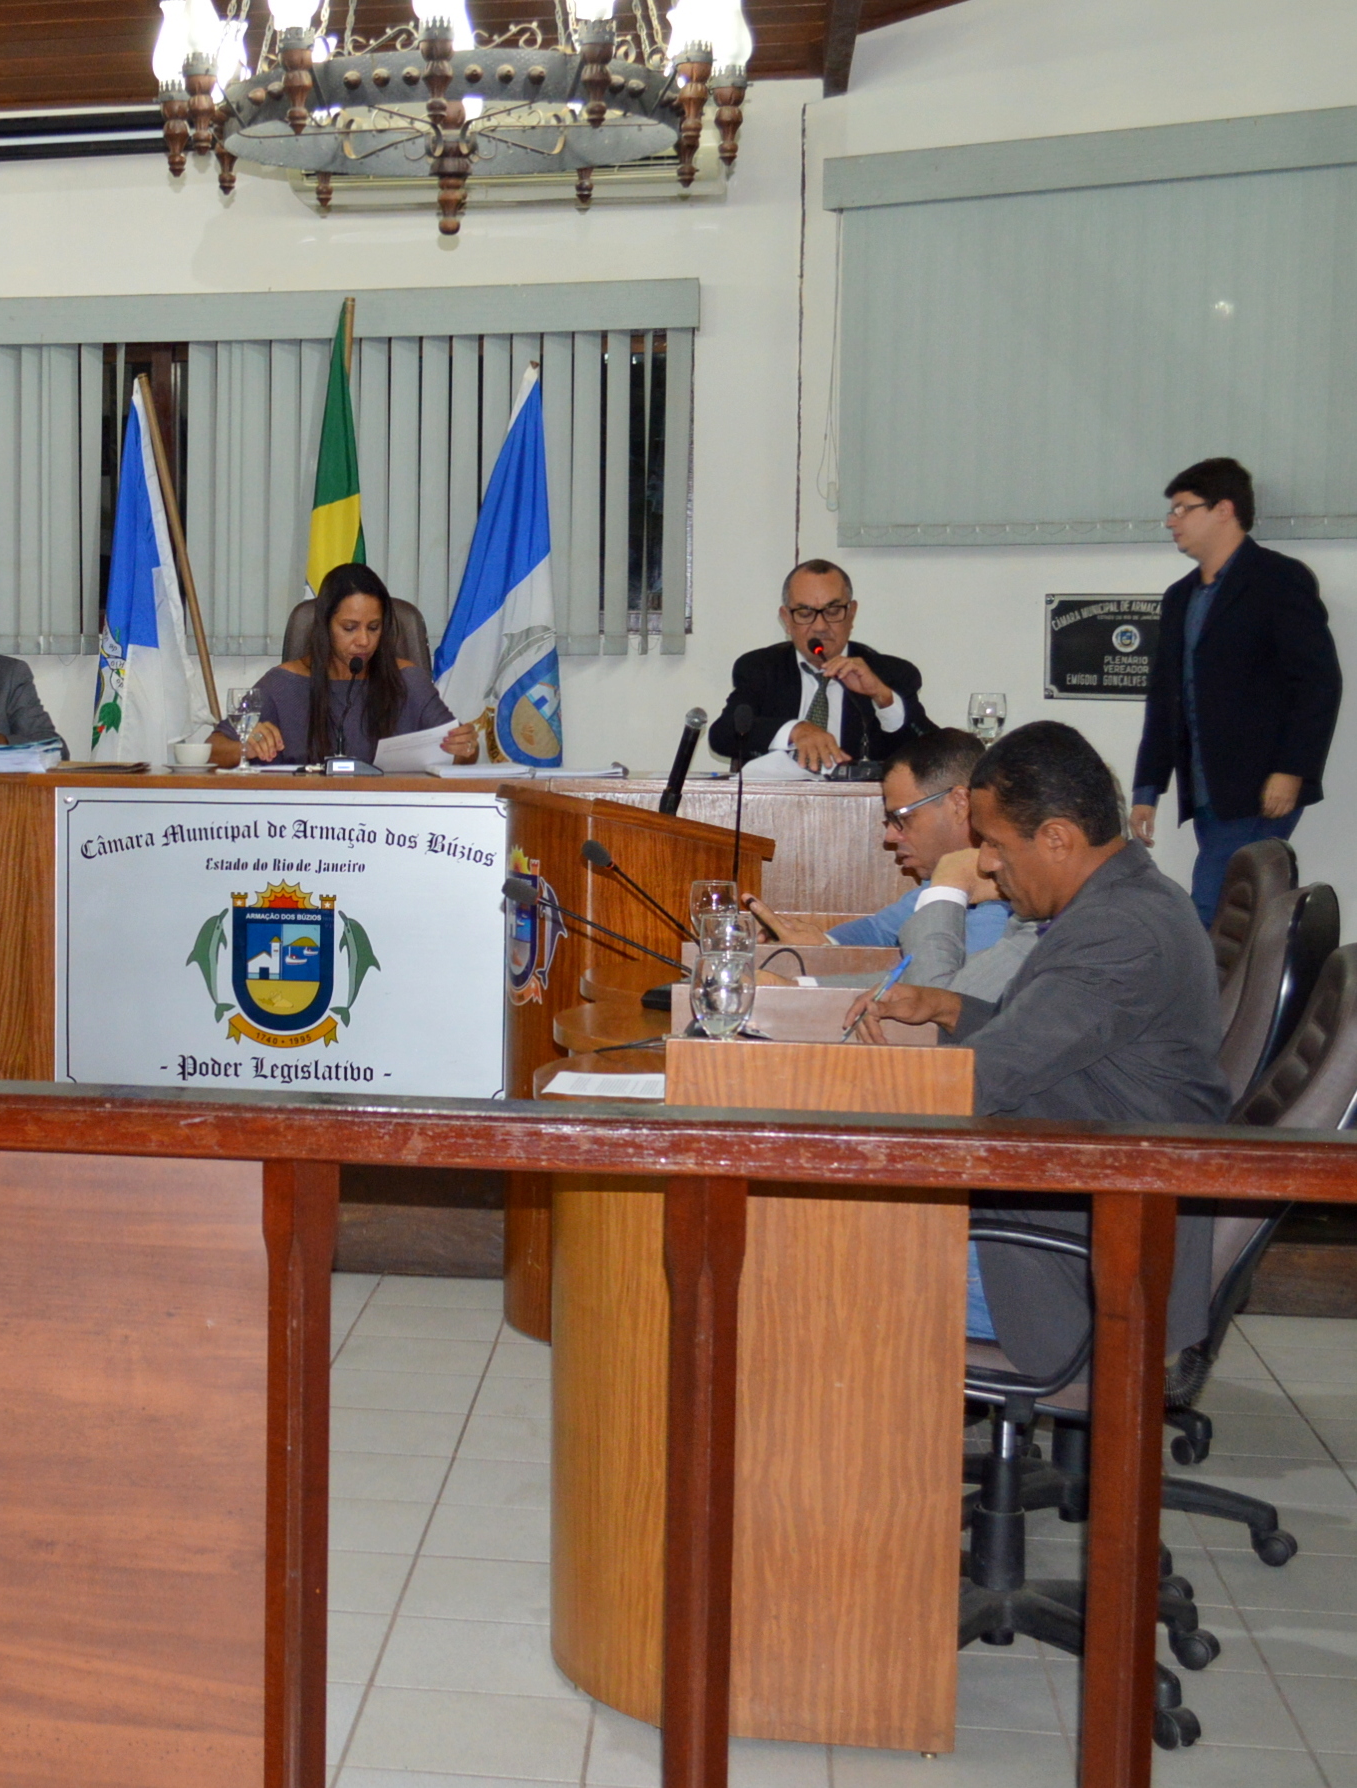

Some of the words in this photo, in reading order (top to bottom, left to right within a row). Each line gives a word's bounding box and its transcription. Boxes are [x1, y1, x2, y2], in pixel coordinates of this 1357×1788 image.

[1104, 655, 1148, 665] PLENÁRIO
[1103, 664, 1150, 674] VEREADOR
[80, 832, 155, 859] Câmara
[161, 820, 261, 847] Municipal
[267, 820, 288, 839] de
[291, 819, 377, 849] Armação
[385, 827, 420, 850] dos
[424, 832, 498, 867] Búzios
[205, 857, 249, 871] Estado
[252, 858, 268, 872] do
[272, 858, 294, 872] Rio
[295, 859, 312, 872] de
[314, 859, 366, 874] Janeiro
[246, 912, 280, 921] ARMAÇÃO
[297, 913, 322, 921] BÚZIOS
[256, 1032, 278, 1045] 1740
[289, 1033, 312, 1045] 1995
[176, 1055, 243, 1081] Poder
[250, 1056, 374, 1084] Legislativo
